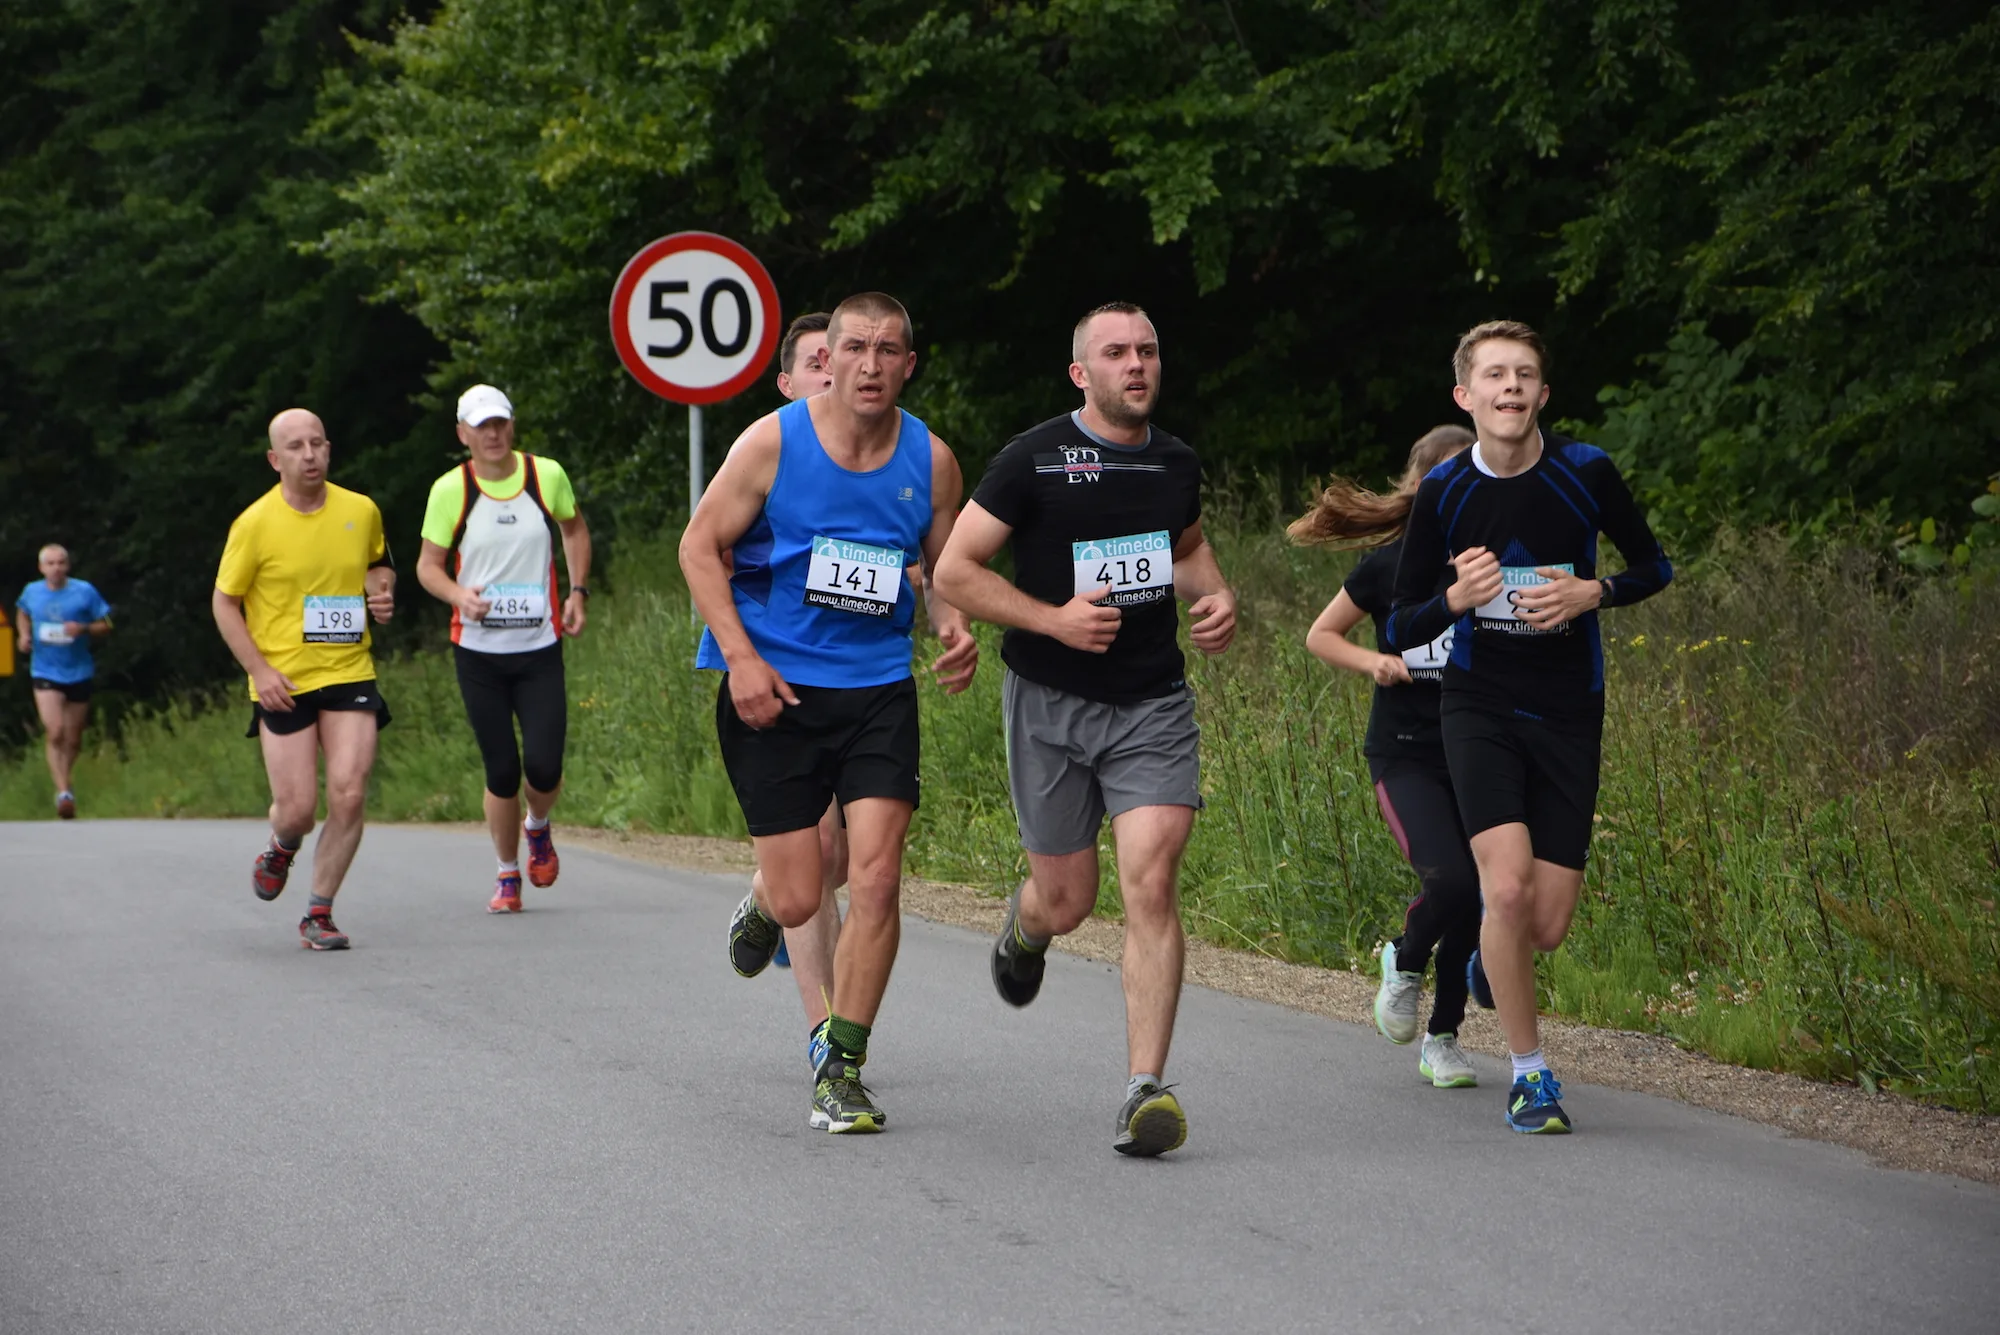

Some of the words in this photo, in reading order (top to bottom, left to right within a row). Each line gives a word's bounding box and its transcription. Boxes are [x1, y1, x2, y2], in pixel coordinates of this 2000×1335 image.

[648, 278, 752, 359] 50
[842, 544, 897, 568] timedo
[1106, 534, 1165, 558] timedo
[828, 563, 877, 595] 141
[1096, 558, 1152, 587] 418
[1506, 565, 1555, 585] time
[323, 597, 361, 609] timedo
[809, 593, 889, 615] www.timedo.pl
[1092, 586, 1166, 606] ww.timedo.pl
[494, 599, 529, 615] 484
[317, 612, 352, 629] 198
[1482, 619, 1569, 632] www.tim.pl
